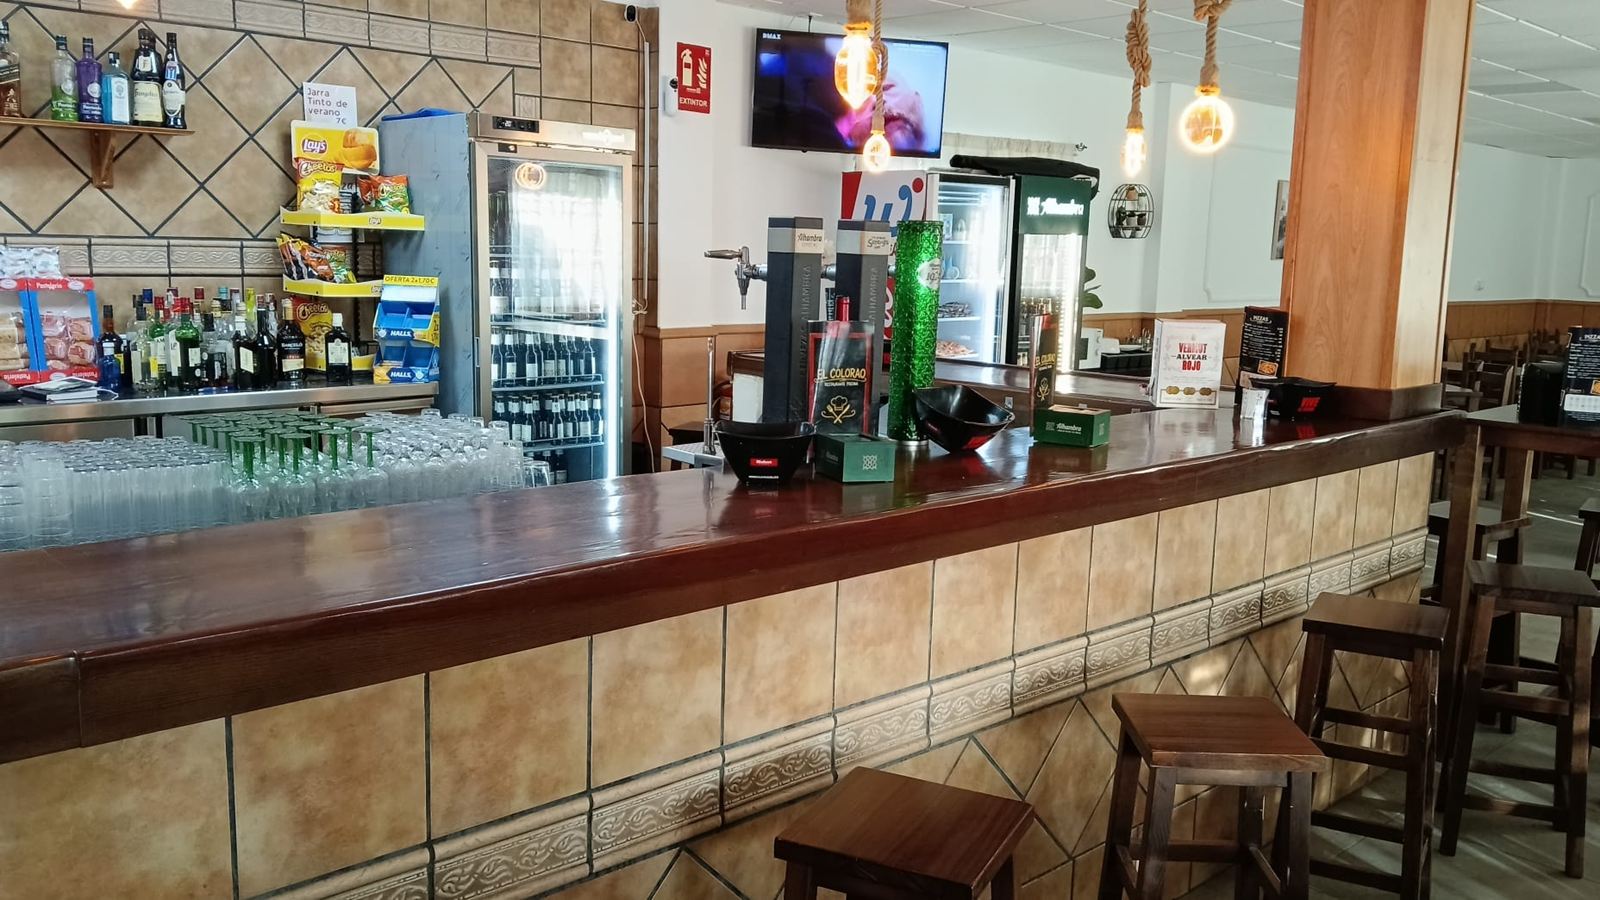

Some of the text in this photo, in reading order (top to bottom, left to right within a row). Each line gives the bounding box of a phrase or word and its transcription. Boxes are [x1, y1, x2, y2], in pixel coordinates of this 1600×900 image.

[307, 87, 330, 97] Jarra
[307, 98, 348, 108] Tinto de
[679, 97, 708, 107] EXTINTOR
[308, 108, 341, 116] verano
[300, 162, 337, 176] Cheetos
[797, 232, 822, 242] Alhambra
[384, 275, 410, 284] OFERTA
[297, 302, 329, 319] Cheetos
[390, 329, 412, 338] HALLS
[1182, 360, 1201, 371] ROJO
[817, 367, 866, 379] EL COLORAO
[1056, 422, 1082, 432] Alhambra
